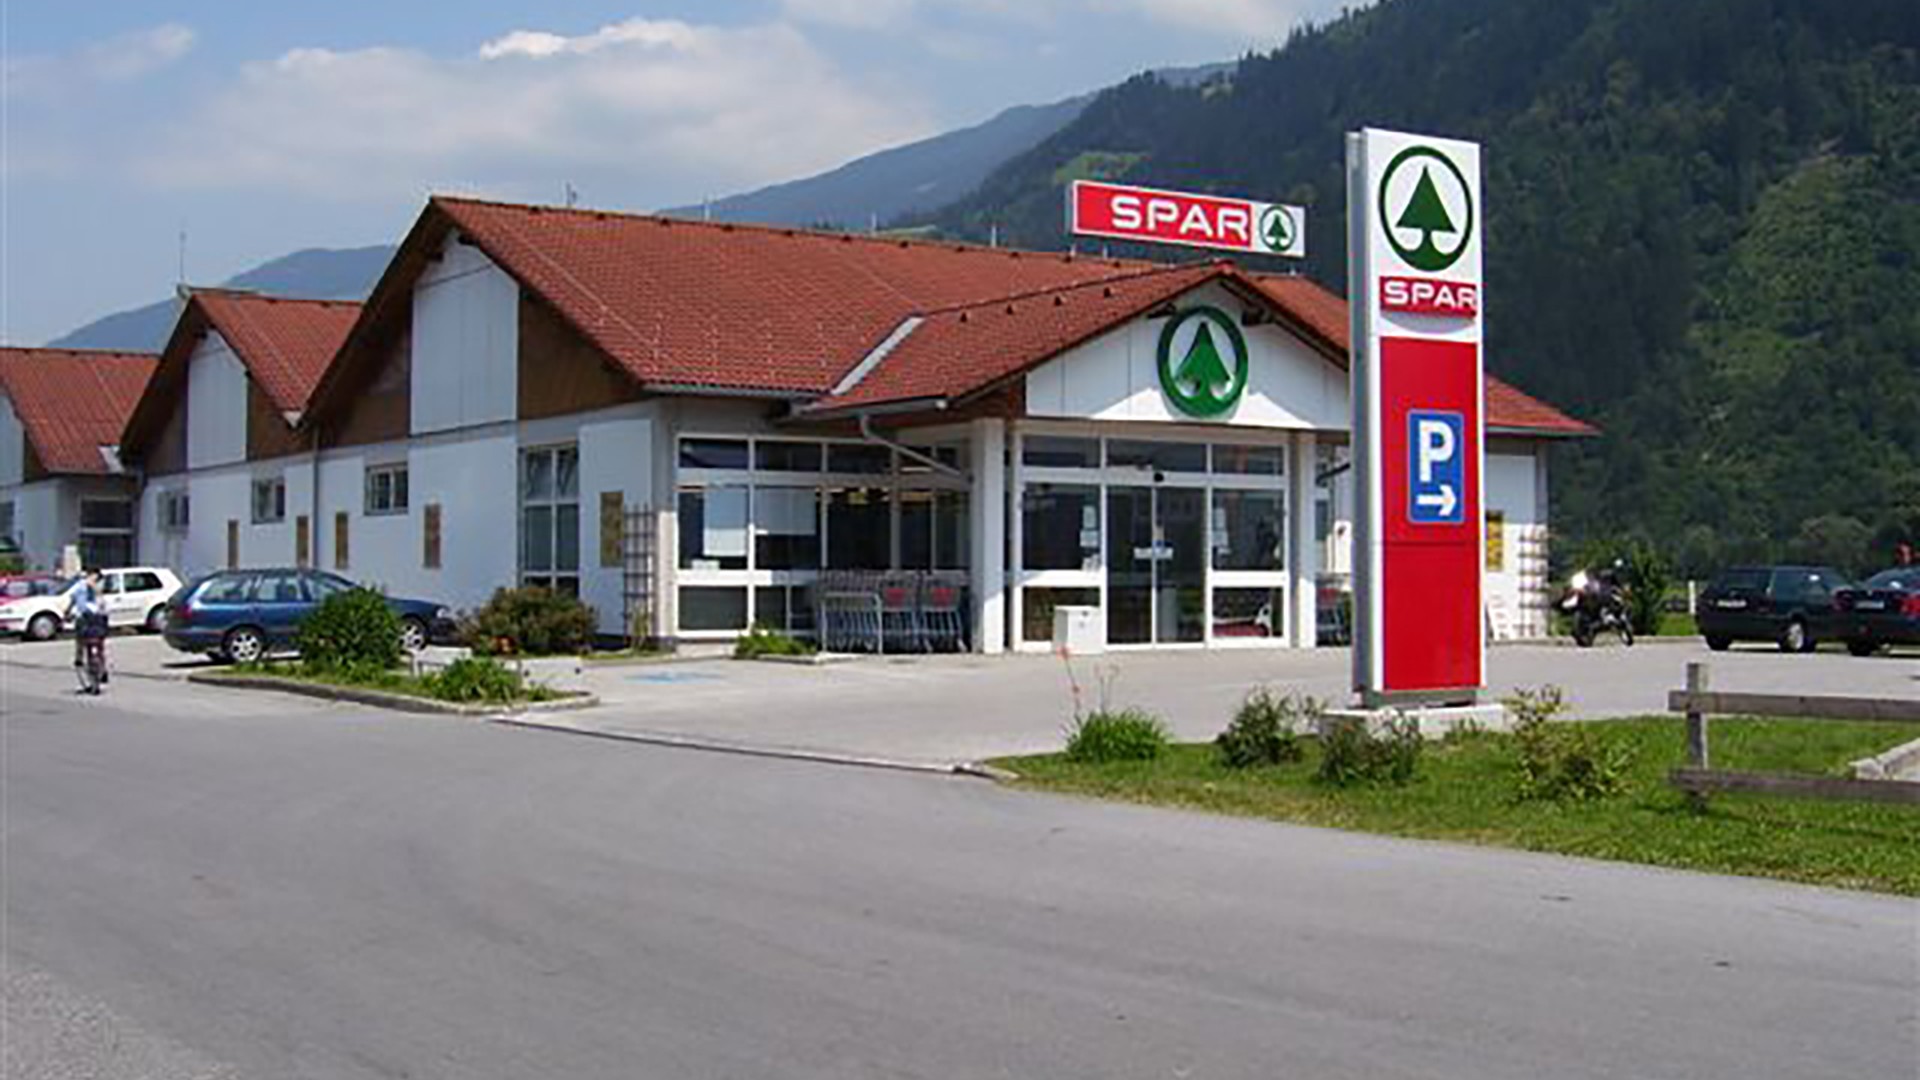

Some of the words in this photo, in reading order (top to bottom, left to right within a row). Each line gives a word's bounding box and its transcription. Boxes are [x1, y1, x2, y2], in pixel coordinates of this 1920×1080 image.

[1111, 196, 1248, 241] SPAR
[1383, 281, 1476, 309] SPAR
[1419, 420, 1455, 482] P
